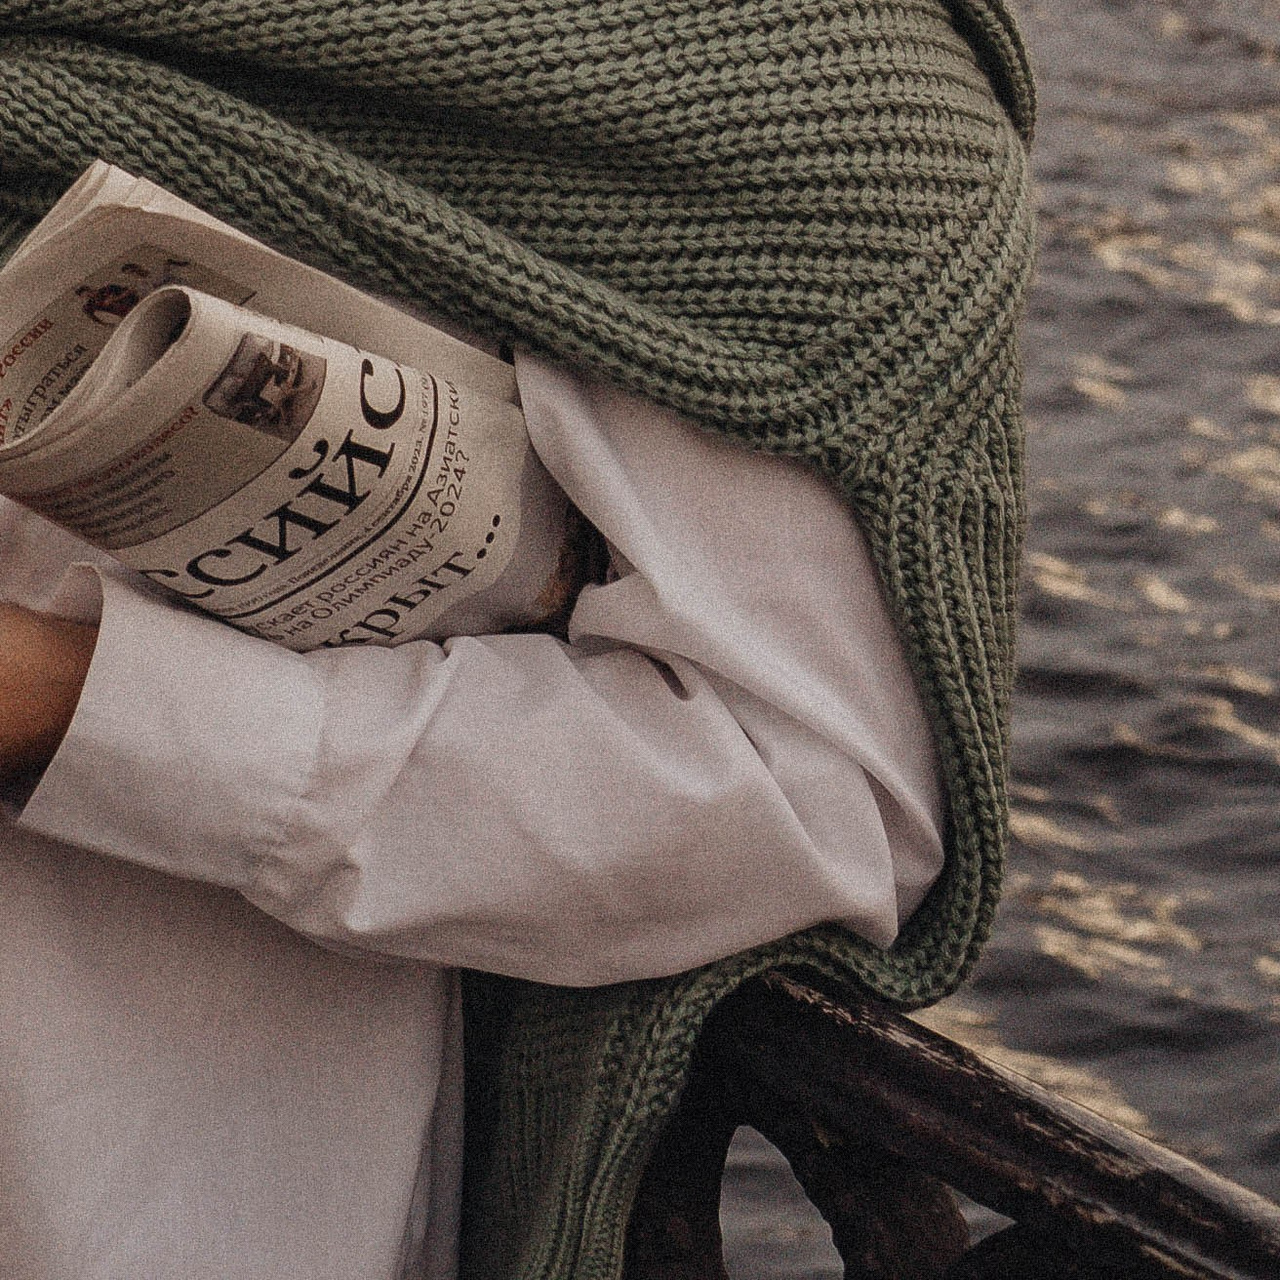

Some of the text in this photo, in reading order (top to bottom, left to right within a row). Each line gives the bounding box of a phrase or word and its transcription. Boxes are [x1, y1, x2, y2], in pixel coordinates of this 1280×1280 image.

[283, 448, 471, 638] на Олимпиаду-2024?
[315, 538, 409, 604] россиян
[405, 510, 433, 538] на
